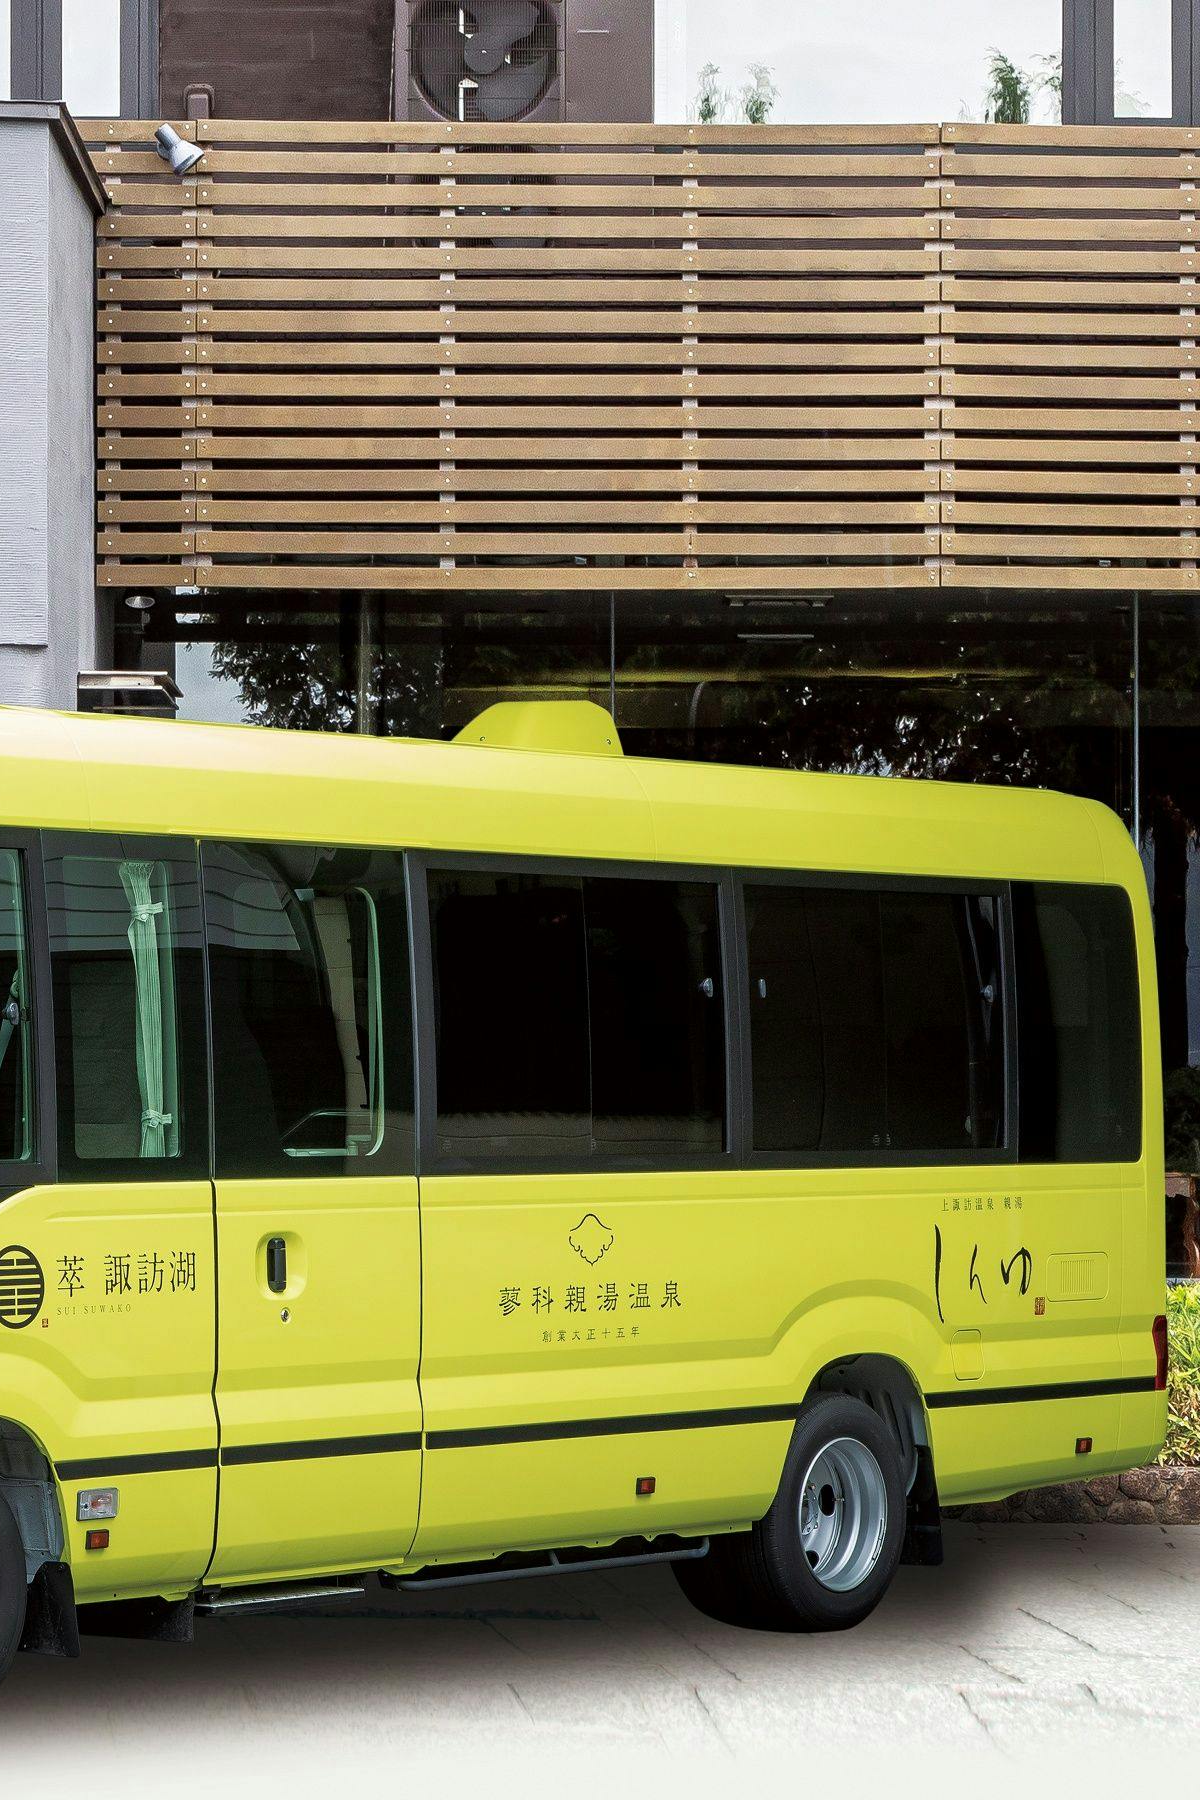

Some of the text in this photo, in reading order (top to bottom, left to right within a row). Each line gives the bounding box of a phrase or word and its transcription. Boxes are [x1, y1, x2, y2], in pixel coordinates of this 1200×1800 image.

[103, 1250, 196, 1296] 諏訪湖
[56, 1303, 132, 1316] SUI SUWAKO
[498, 1280, 682, 1316] 蓼科親湯温泉
